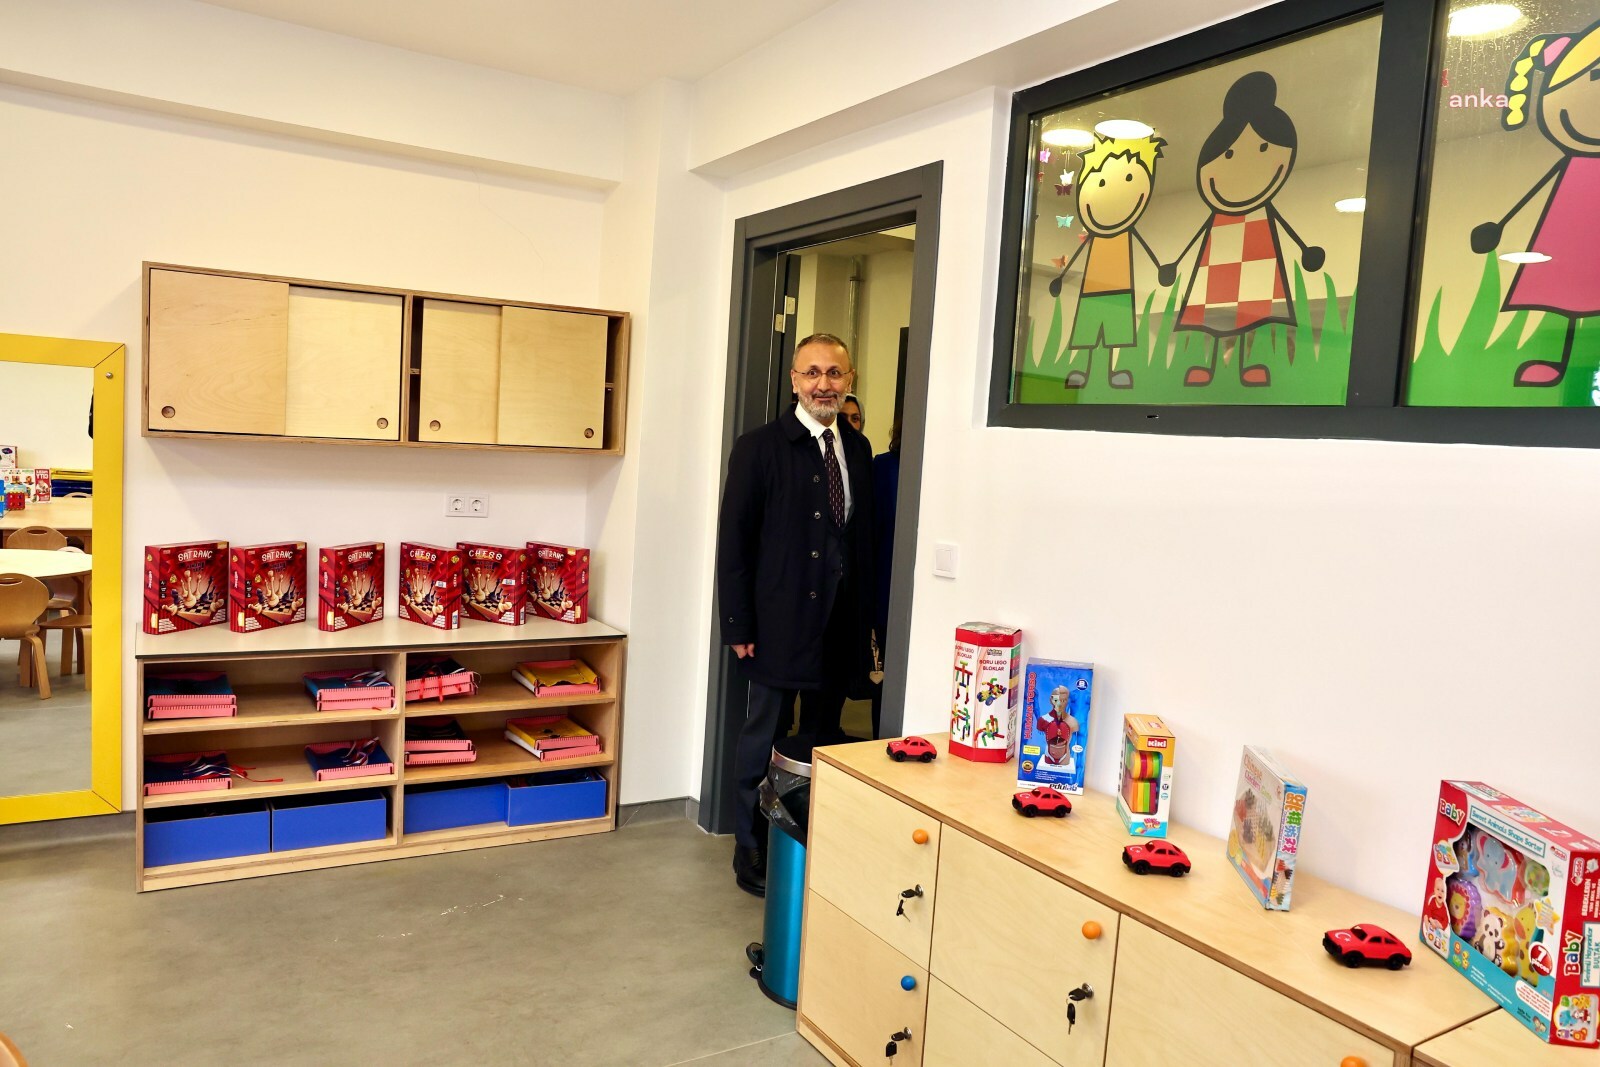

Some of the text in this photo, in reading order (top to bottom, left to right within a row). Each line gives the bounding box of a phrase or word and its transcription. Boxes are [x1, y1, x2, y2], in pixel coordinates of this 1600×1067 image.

[468, 549, 503, 560] CHESS
[1026, 671, 1037, 703] TORSO
[1024, 705, 1034, 740] HUMAN
[1439, 798, 1466, 827] Baby
[1471, 810, 1543, 853] Sweet Animals Shape Sorter
[1531, 957, 1551, 975] pieces
[1537, 945, 1547, 963] 7
[1562, 929, 1584, 977] Baby
[1584, 927, 1593, 983] Sevimli Hayvanlar
